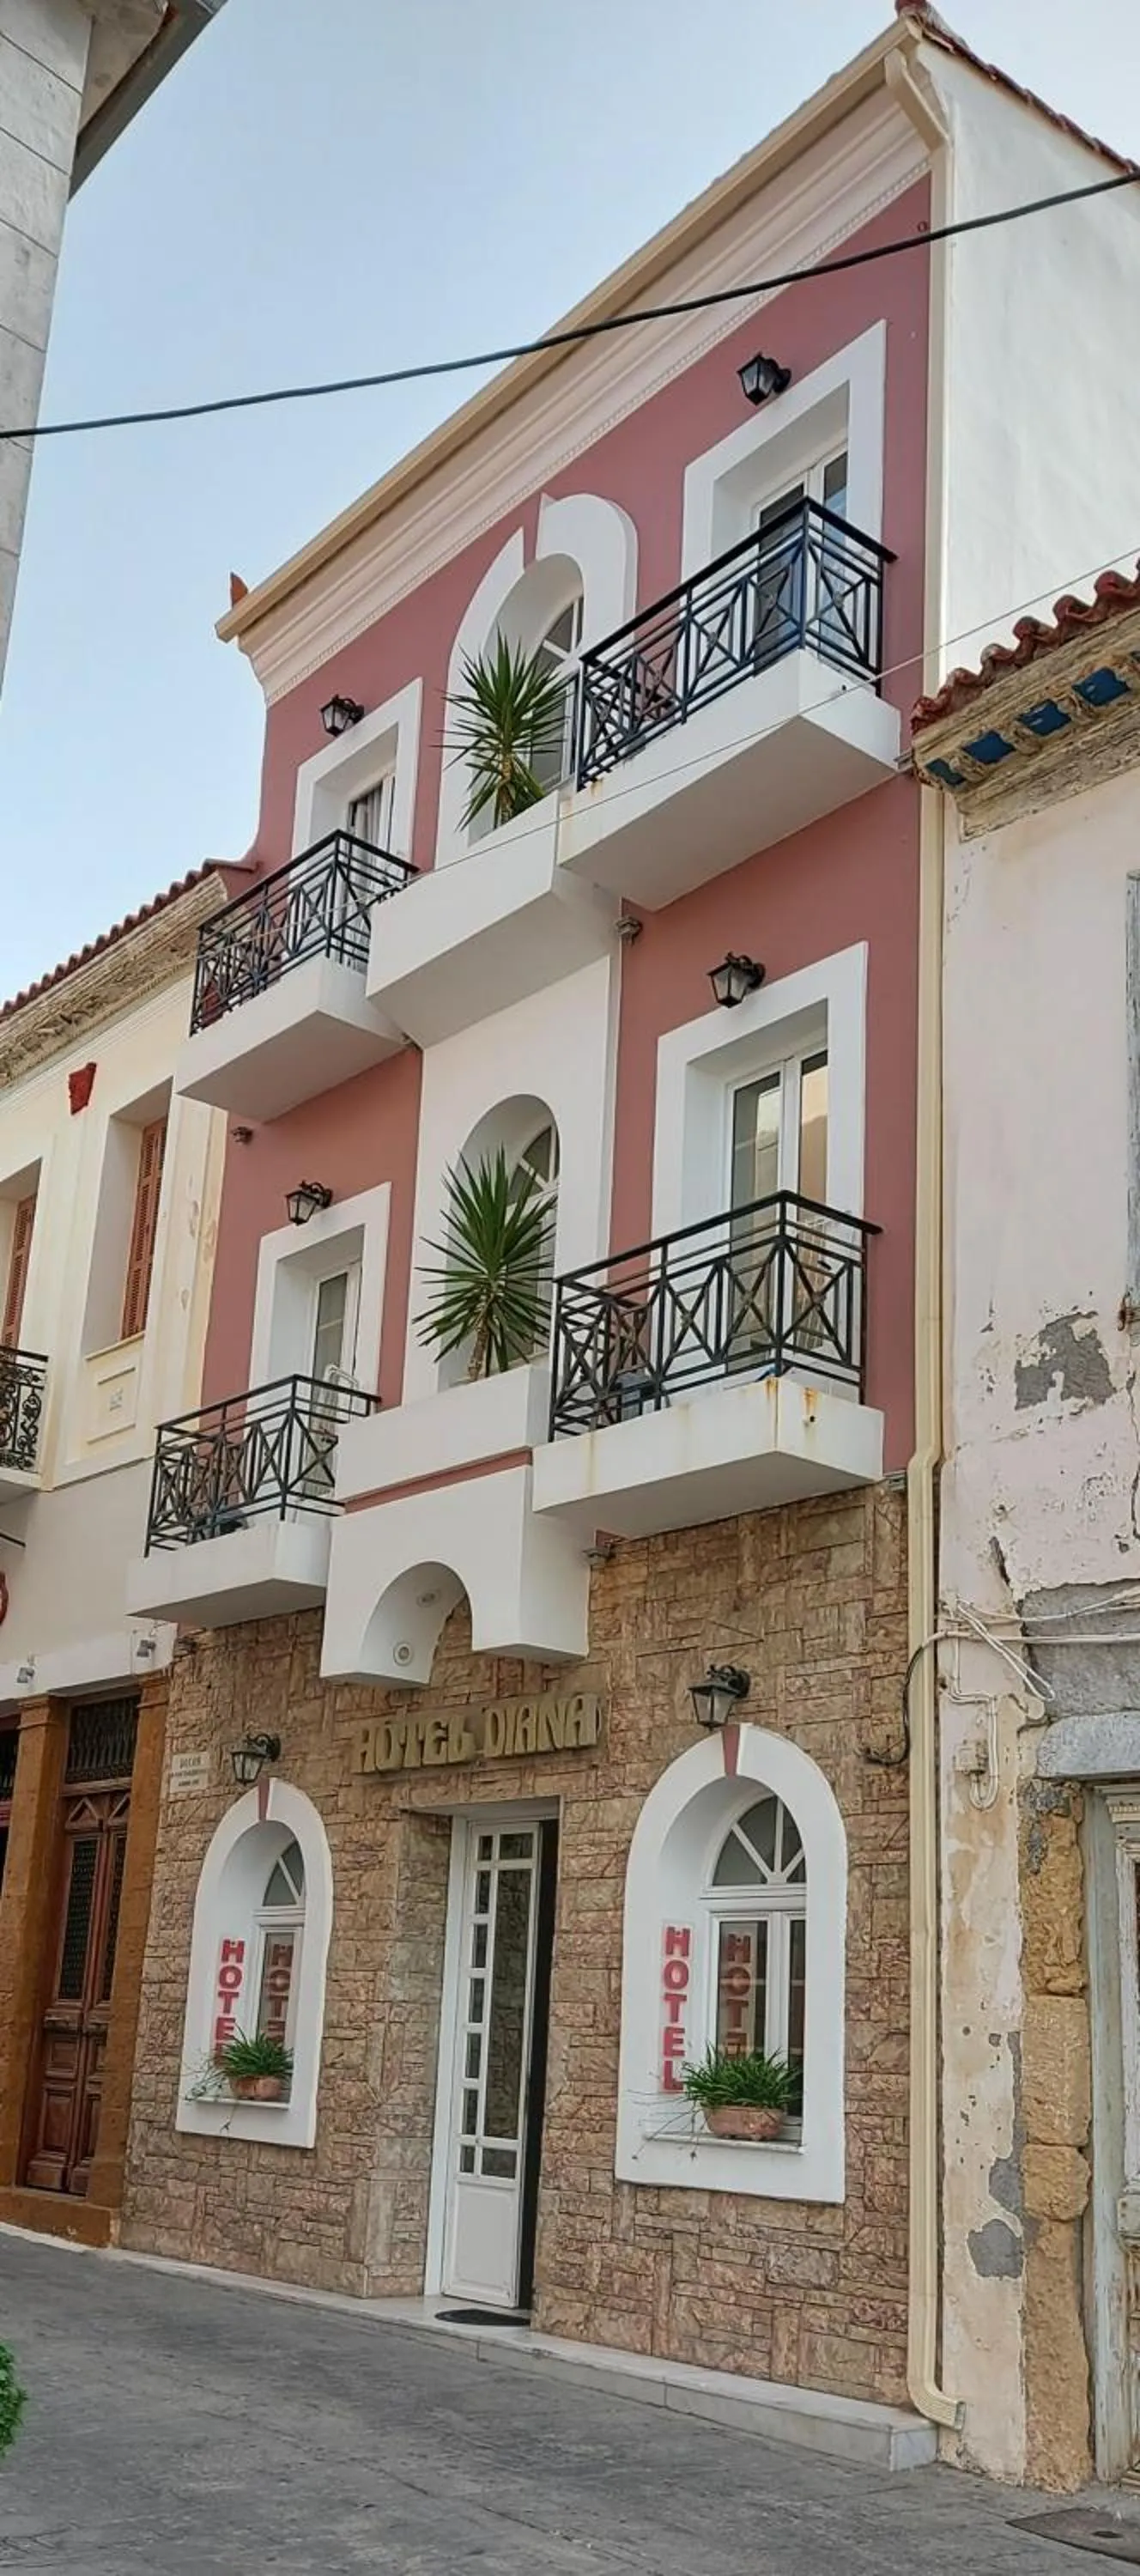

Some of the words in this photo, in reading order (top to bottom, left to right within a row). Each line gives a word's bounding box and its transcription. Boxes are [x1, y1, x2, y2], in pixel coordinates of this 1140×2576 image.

[350, 1716, 473, 1774] HOTEL
[483, 1692, 599, 1759] DIANA
[664, 1926, 690, 2091] HOTEL
